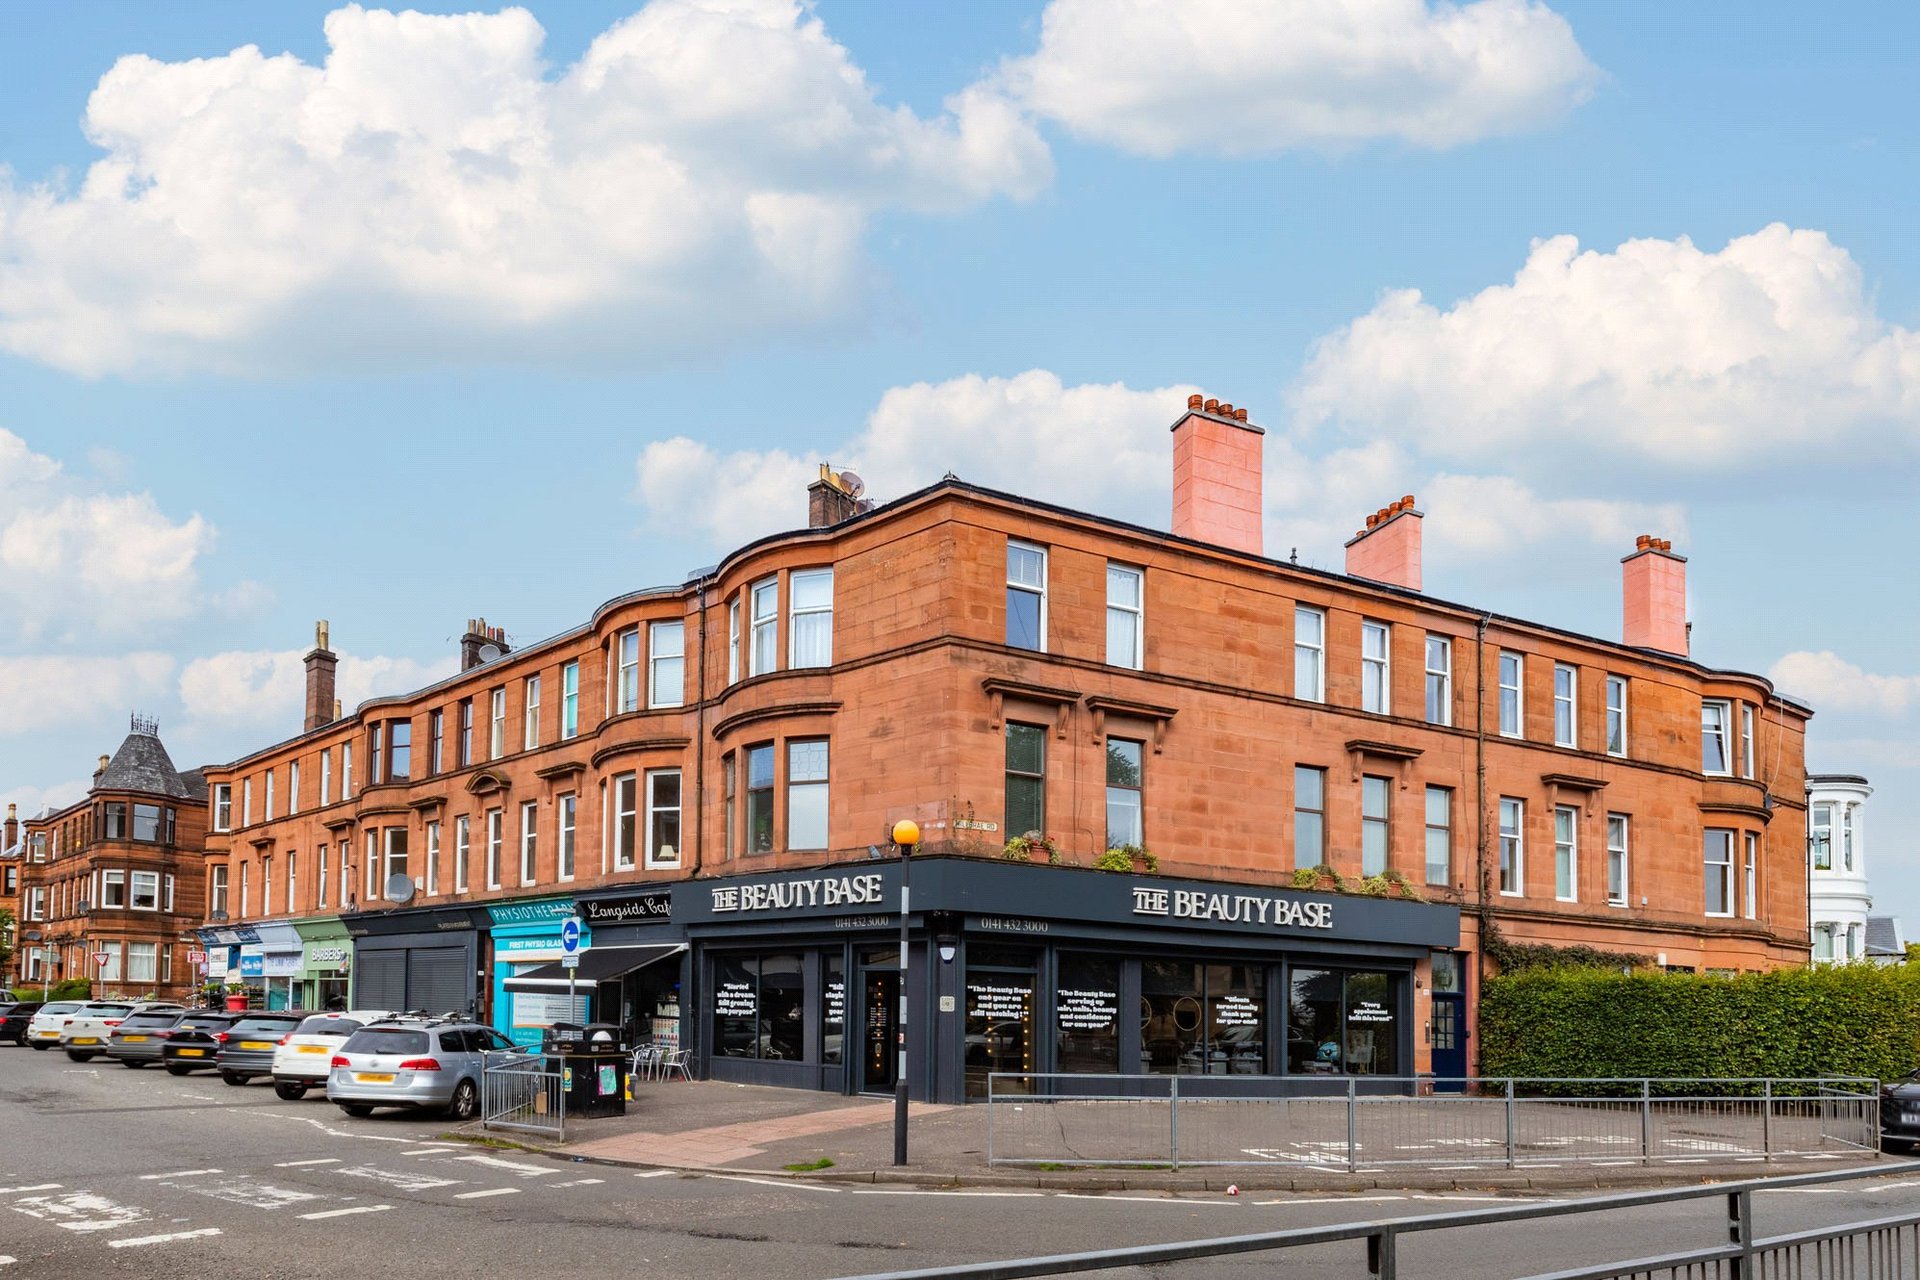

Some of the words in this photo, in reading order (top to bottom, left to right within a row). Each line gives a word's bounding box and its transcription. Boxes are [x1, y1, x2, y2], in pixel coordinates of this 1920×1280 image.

[712, 889, 738, 909] THE
[741, 879, 822, 910] BEAUTY
[823, 874, 883, 906] BASE
[587, 902, 646, 920] Langside
[1133, 890, 1169, 911] THE
[1173, 890, 1272, 923] BEAUTY
[1273, 899, 1333, 929] BASE
[867, 915, 889, 926] 3000
[981, 917, 1001, 930] 0141
[1003, 919, 1021, 931] 432
[1022, 920, 1048, 932] 3000
[546, 939, 562, 948] GLAS
[312, 947, 341, 961] BARBERS
[986, 986, 1013, 994] Beauty
[1073, 990, 1099, 998] Beauty
[1067, 998, 1095, 1006] serving
[1093, 1006, 1117, 1014] beauty
